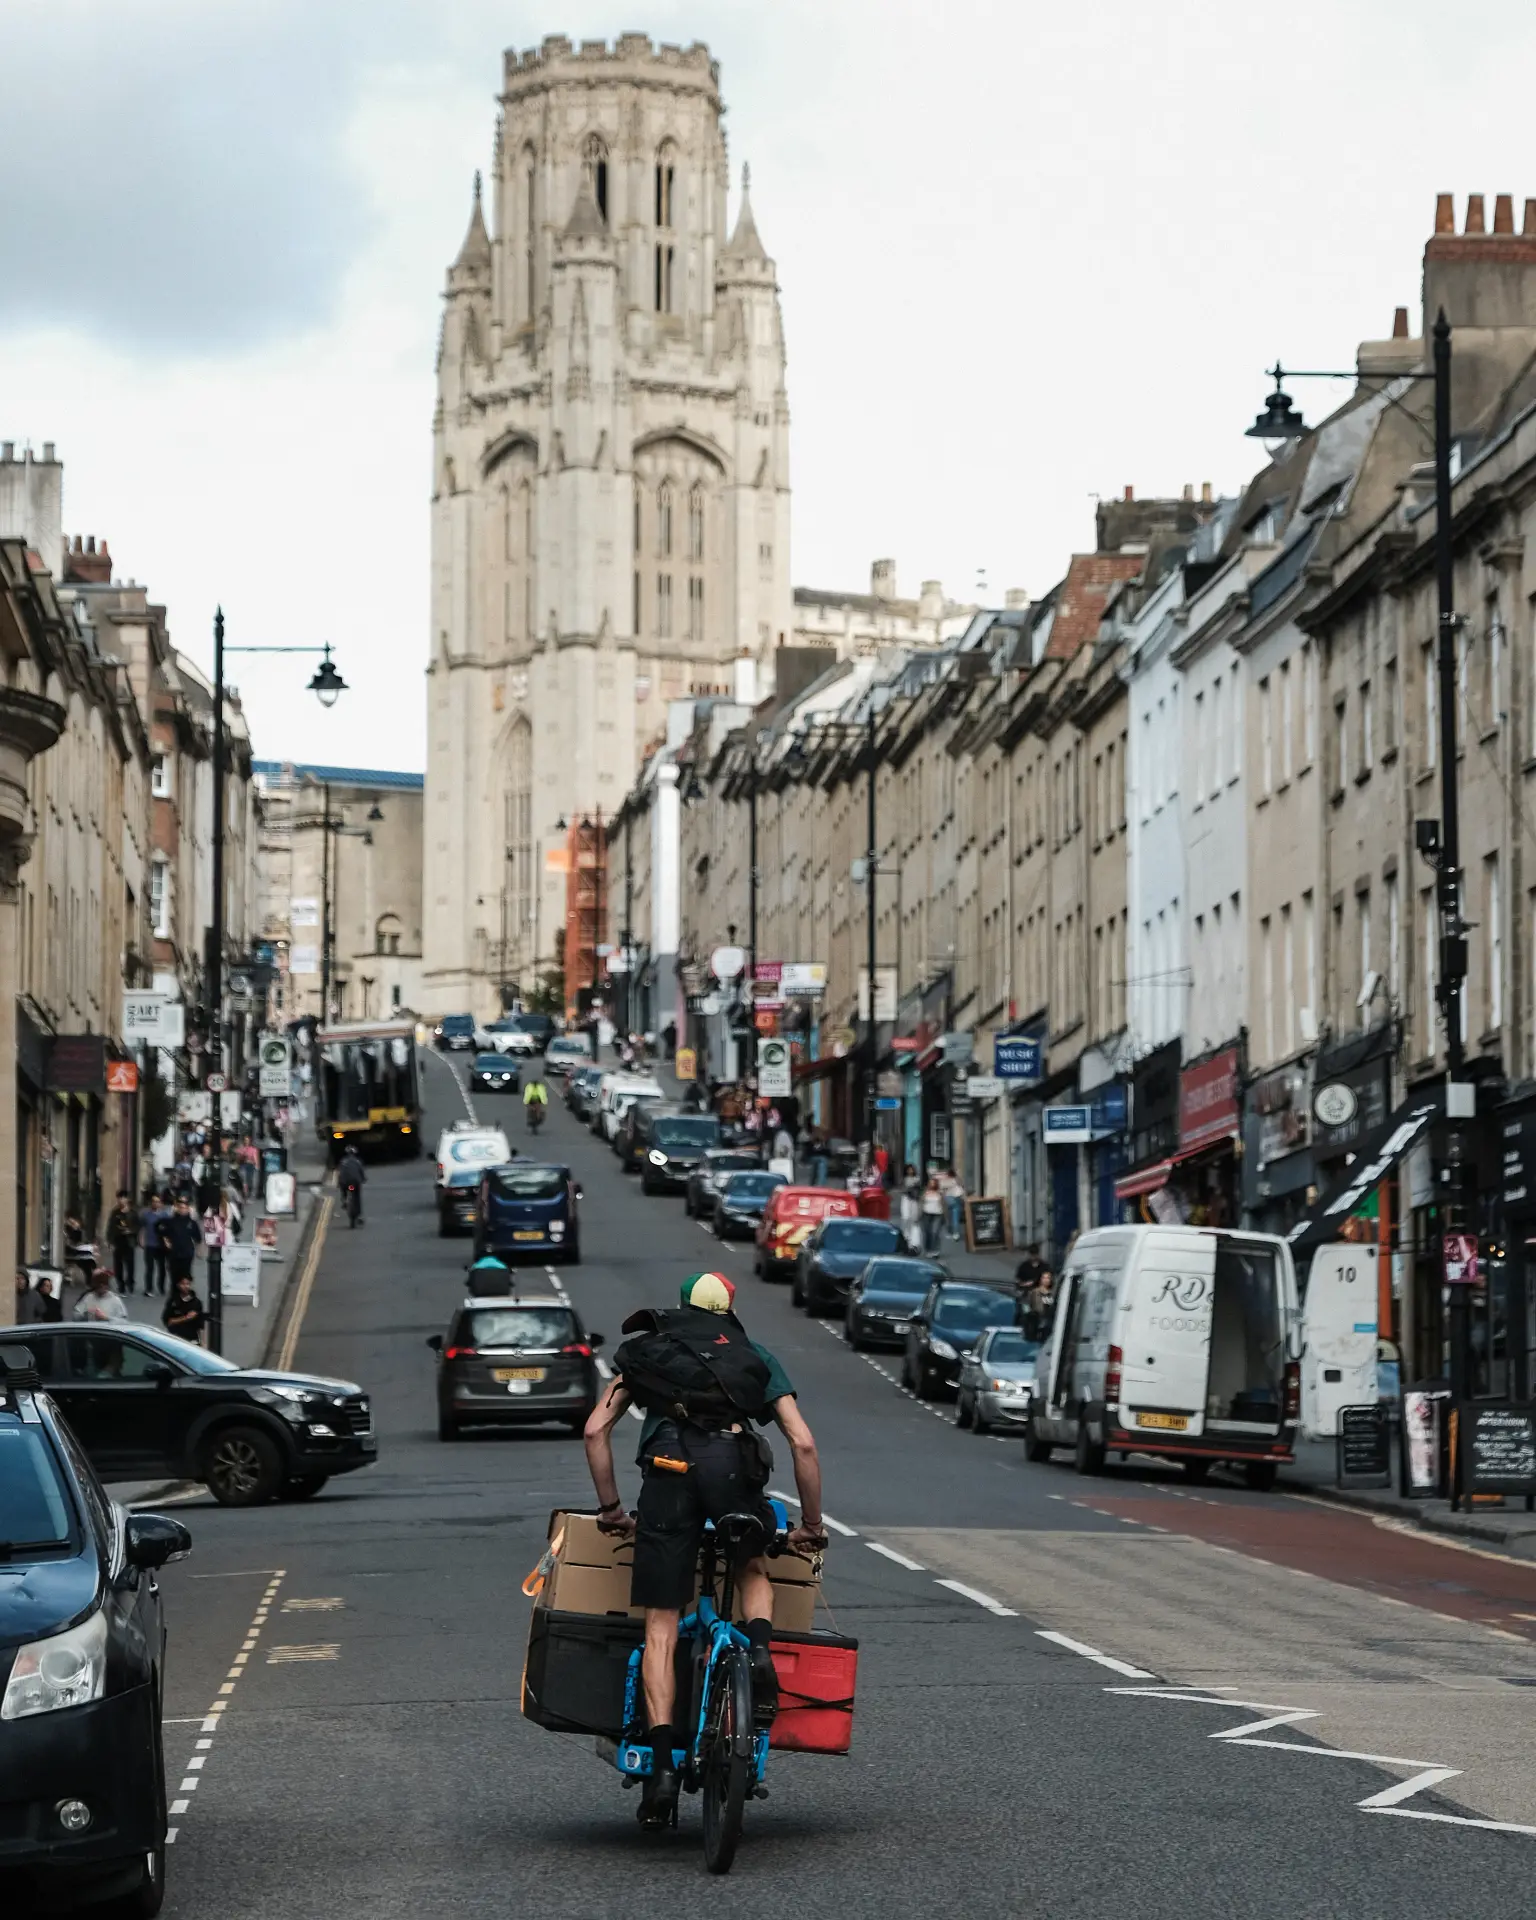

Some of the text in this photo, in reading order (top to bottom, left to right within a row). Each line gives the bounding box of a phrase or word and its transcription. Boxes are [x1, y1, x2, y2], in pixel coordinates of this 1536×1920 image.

[1000, 1062, 1034, 1073] SHOP
[1335, 1266, 1357, 1283] 10
[1149, 1316, 1209, 1333] FOODS
